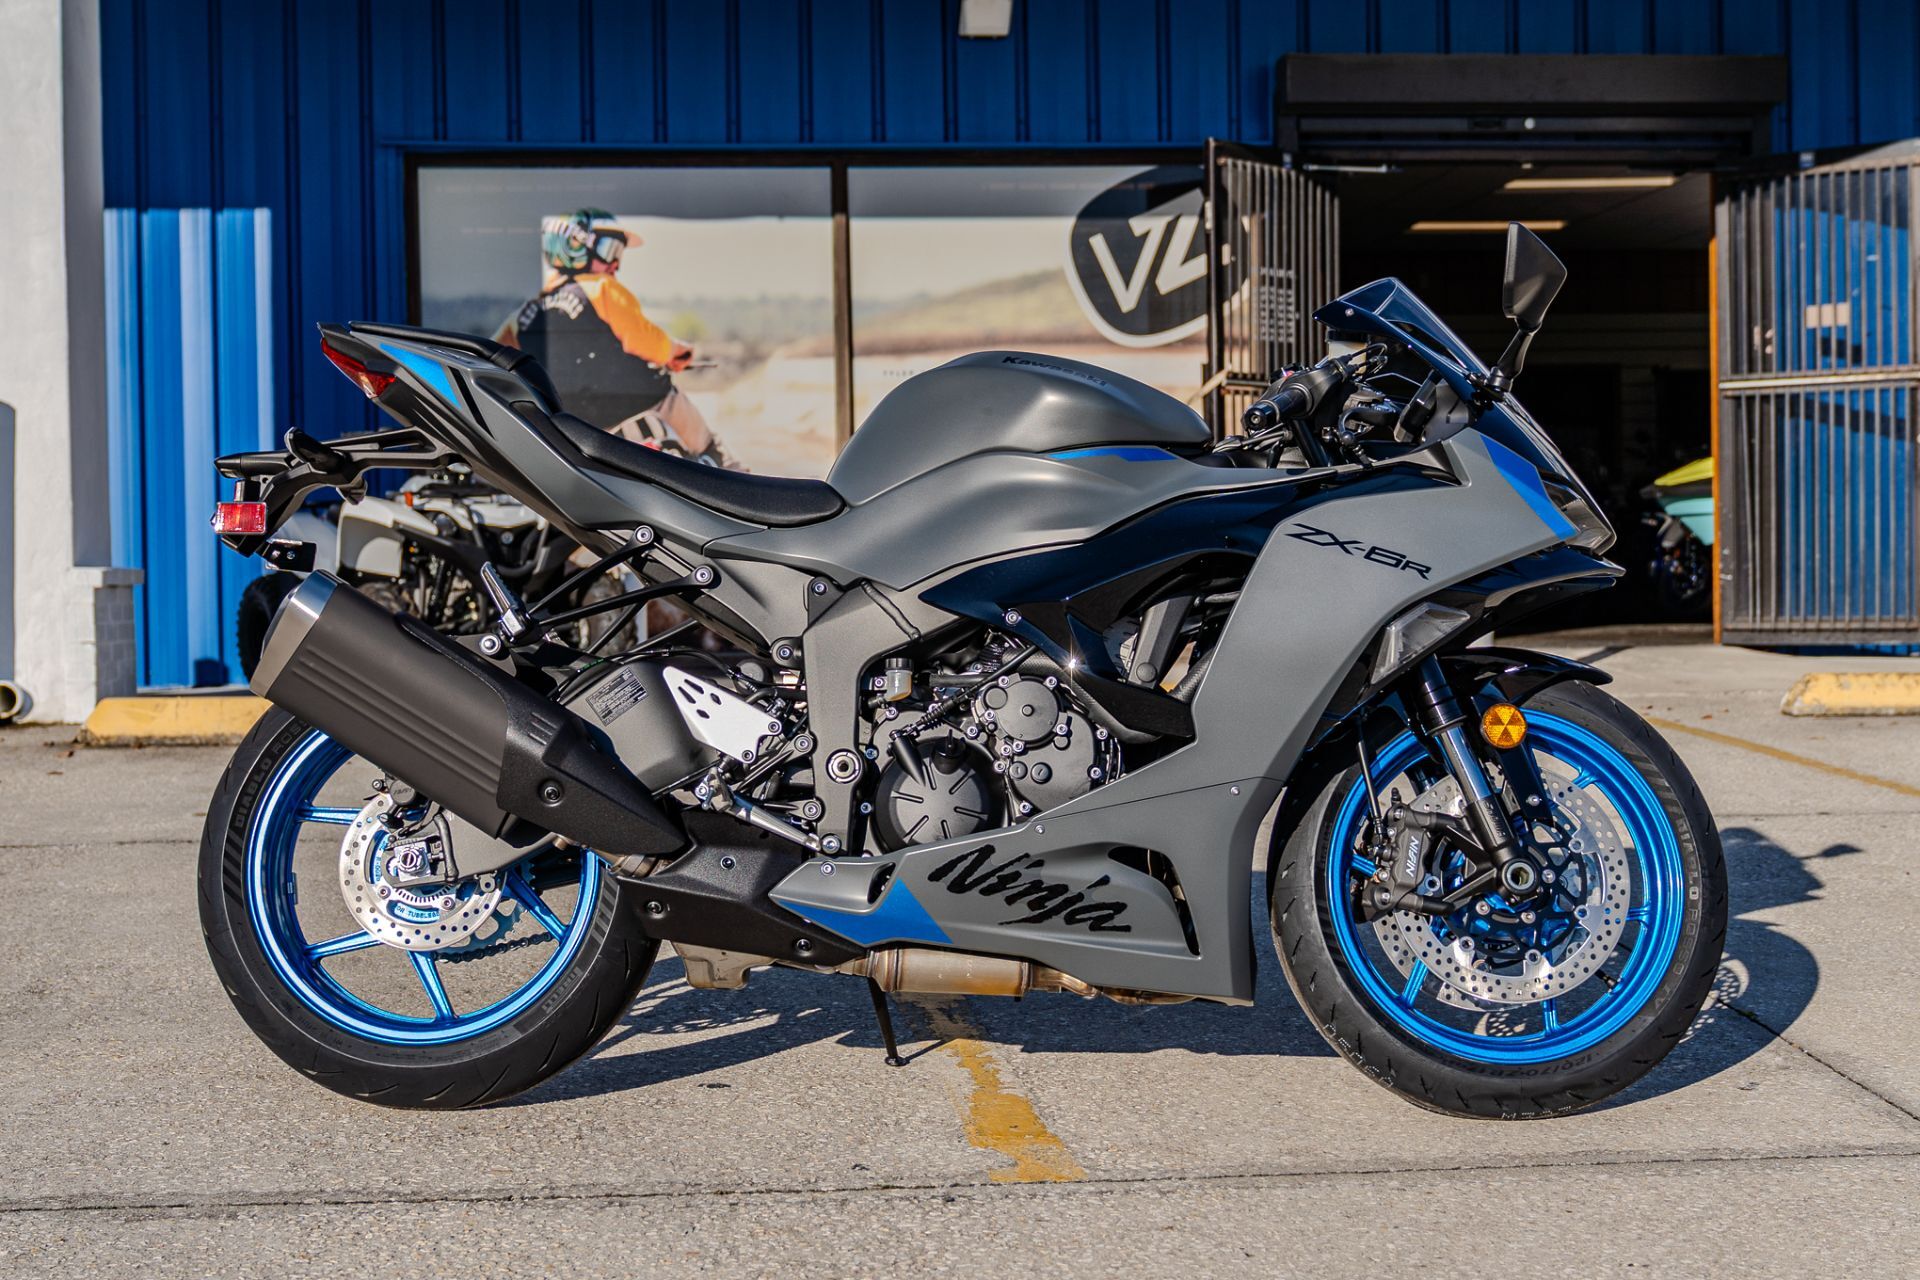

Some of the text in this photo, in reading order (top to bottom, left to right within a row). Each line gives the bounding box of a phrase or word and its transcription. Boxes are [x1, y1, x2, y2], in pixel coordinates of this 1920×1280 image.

[1001, 355, 1108, 387] Kawasaki
[1284, 522, 1432, 581] ZX-6R
[234, 757, 273, 829] DIABLO
[1404, 835, 1422, 878] NISSIN
[927, 844, 1132, 933] Ninja
